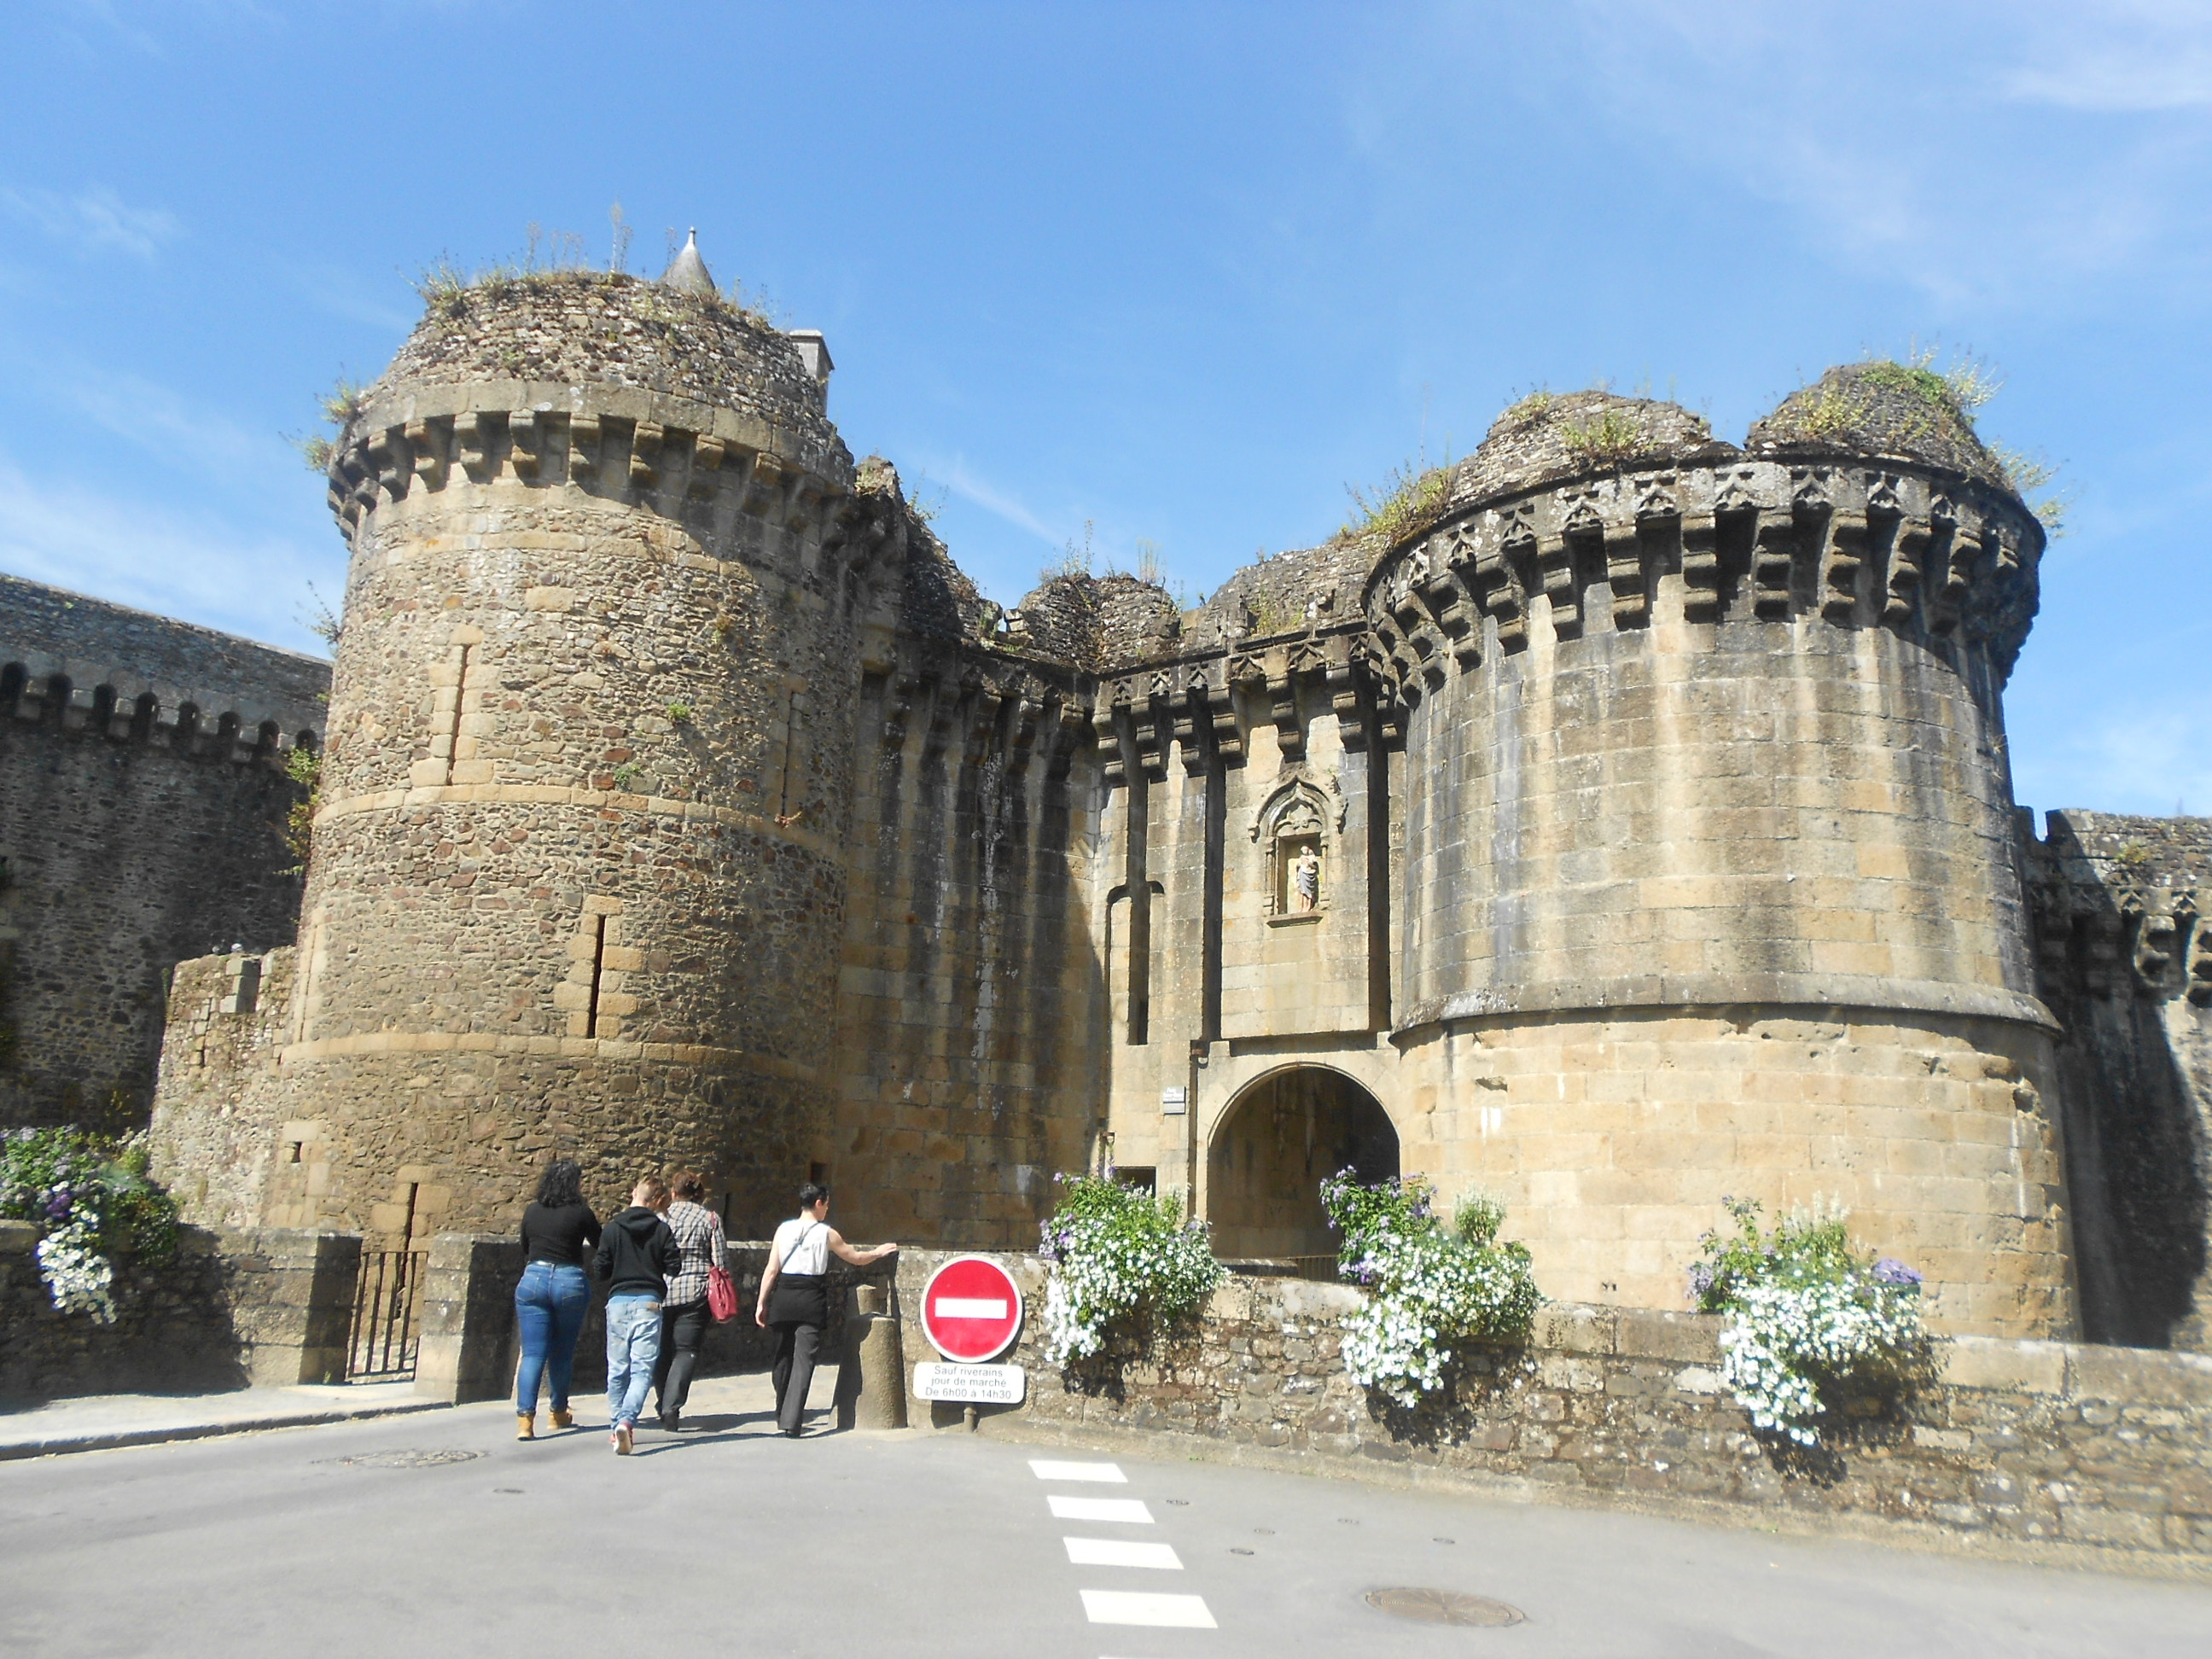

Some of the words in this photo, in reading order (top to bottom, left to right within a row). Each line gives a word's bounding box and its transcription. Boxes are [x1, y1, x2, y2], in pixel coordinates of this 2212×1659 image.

[934, 1365, 957, 1375] Sauf
[960, 1366, 1003, 1377] riverains
[931, 1377, 950, 1386] jour
[953, 1377, 966, 1386] de
[969, 1378, 1007, 1388] marché
[925, 1387, 940, 1396] De
[942, 1388, 968, 1397] 6h00
[970, 1389, 977, 1398] à
[981, 1389, 1011, 1400] 14h30
